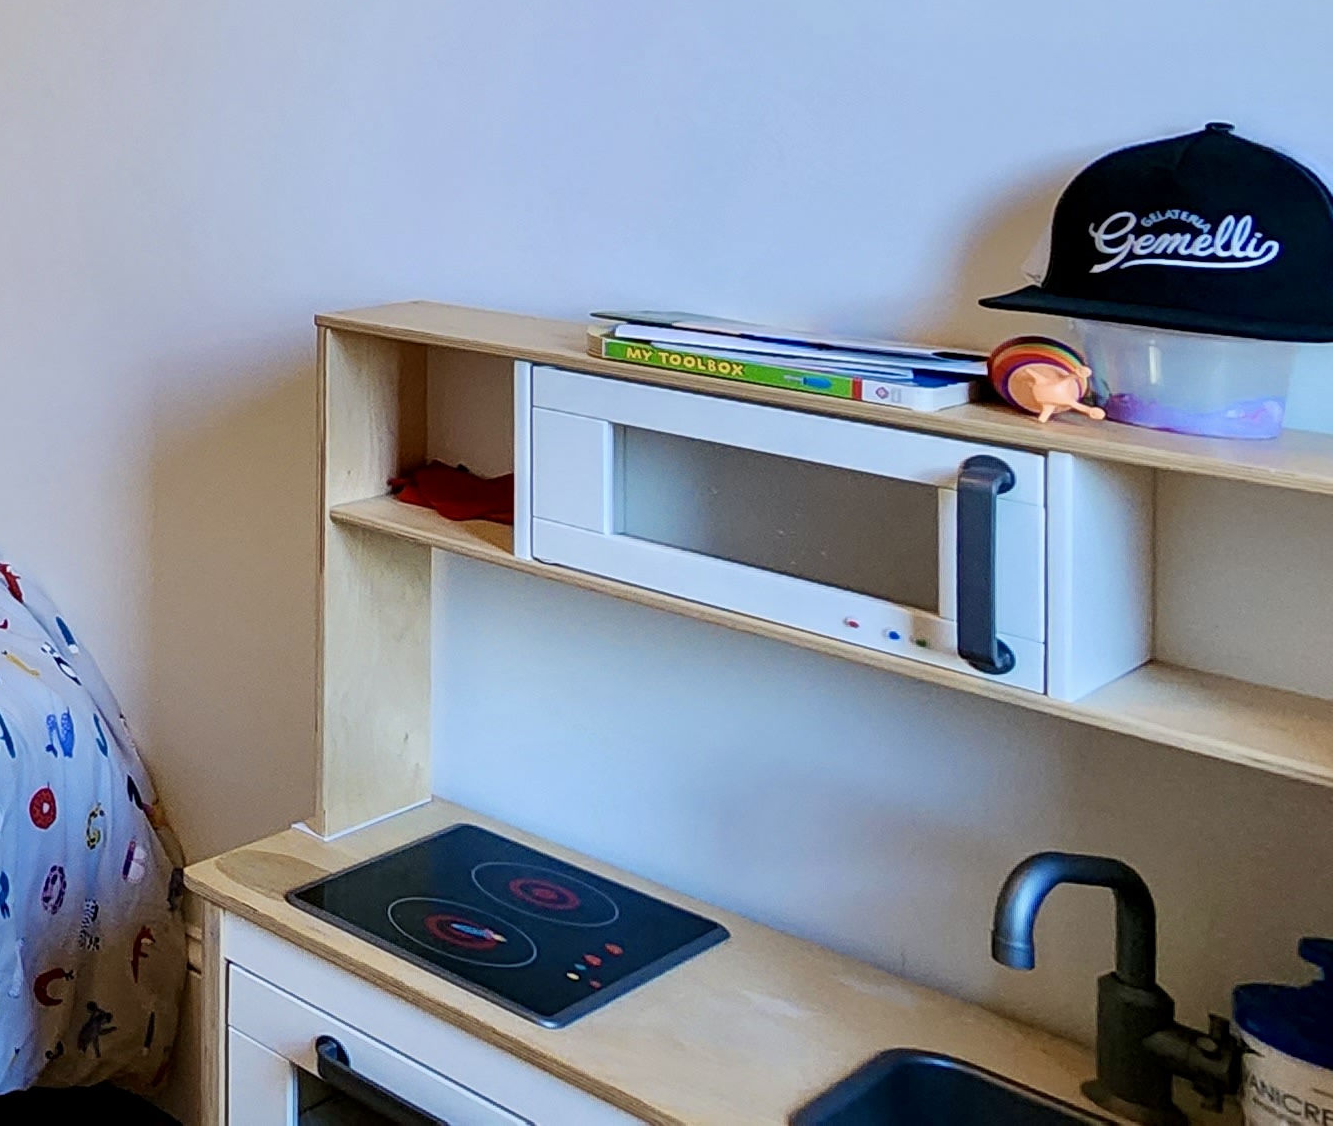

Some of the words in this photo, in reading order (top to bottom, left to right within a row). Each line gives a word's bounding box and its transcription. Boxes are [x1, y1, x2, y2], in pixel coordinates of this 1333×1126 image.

[1141, 209, 1212, 234] GELATERIA
[1088, 211, 1280, 274] Gemelli
[626, 347, 653, 362] MY
[658, 351, 745, 376] TOOLBOX
[33, 967, 75, 1007] C
